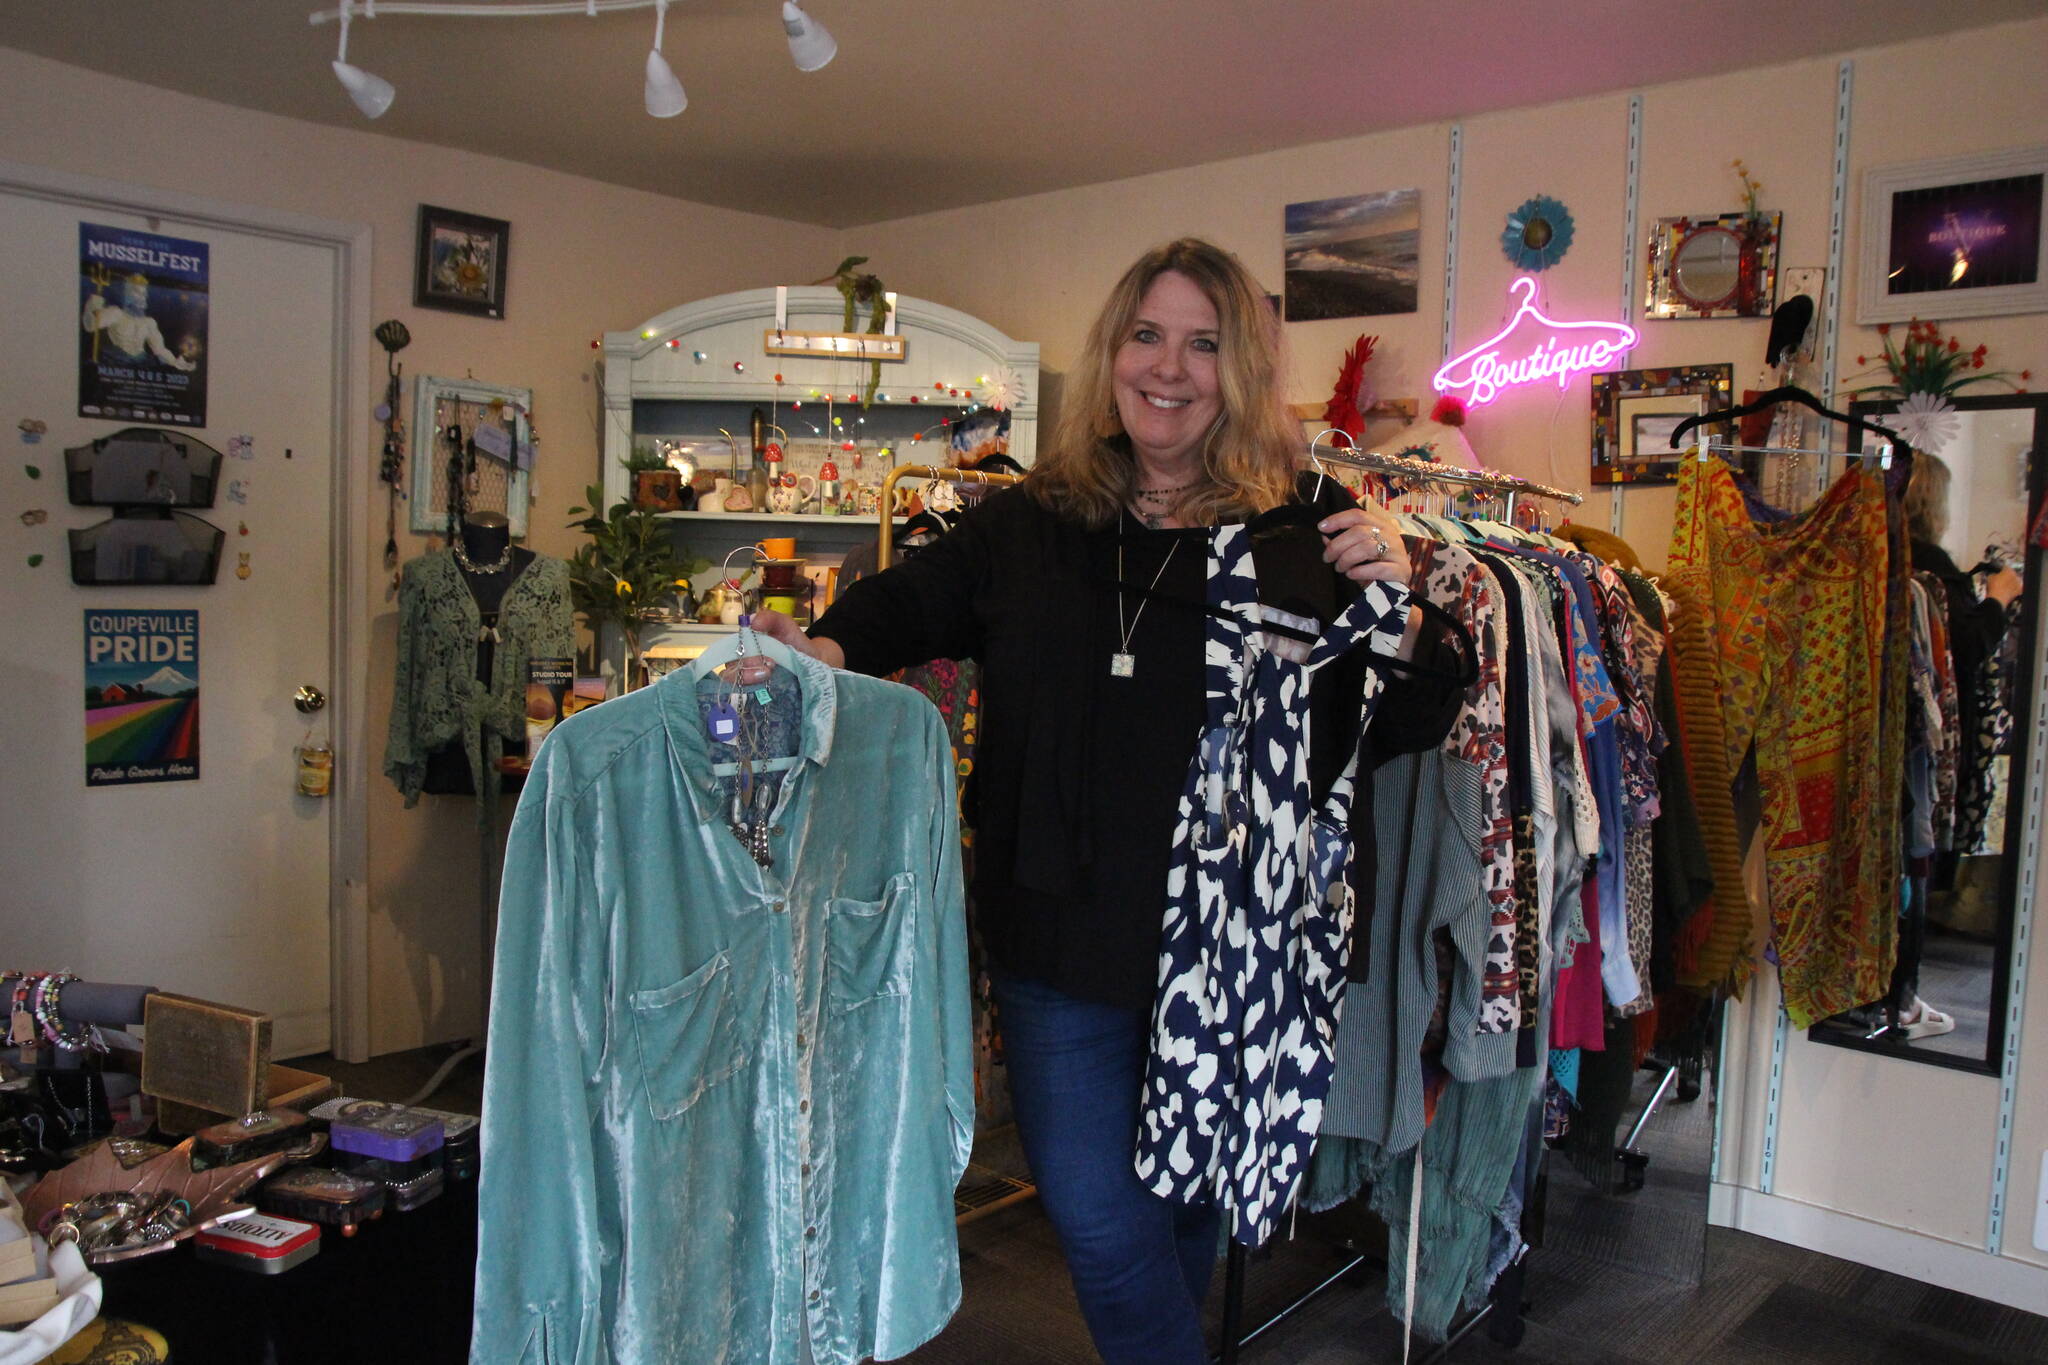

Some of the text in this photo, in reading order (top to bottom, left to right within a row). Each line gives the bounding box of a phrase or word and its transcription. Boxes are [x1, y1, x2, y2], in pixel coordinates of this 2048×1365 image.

[87, 239, 201, 273] MUSSELFEST
[97, 366, 135, 379] MARCH
[1466, 336, 1613, 407] Boutique
[89, 616, 194, 633] COUPEVILLE
[89, 635, 194, 663] PRIDE
[91, 763, 194, 780] Pride Grows Here
[217, 1221, 291, 1241] ALTOIDS
